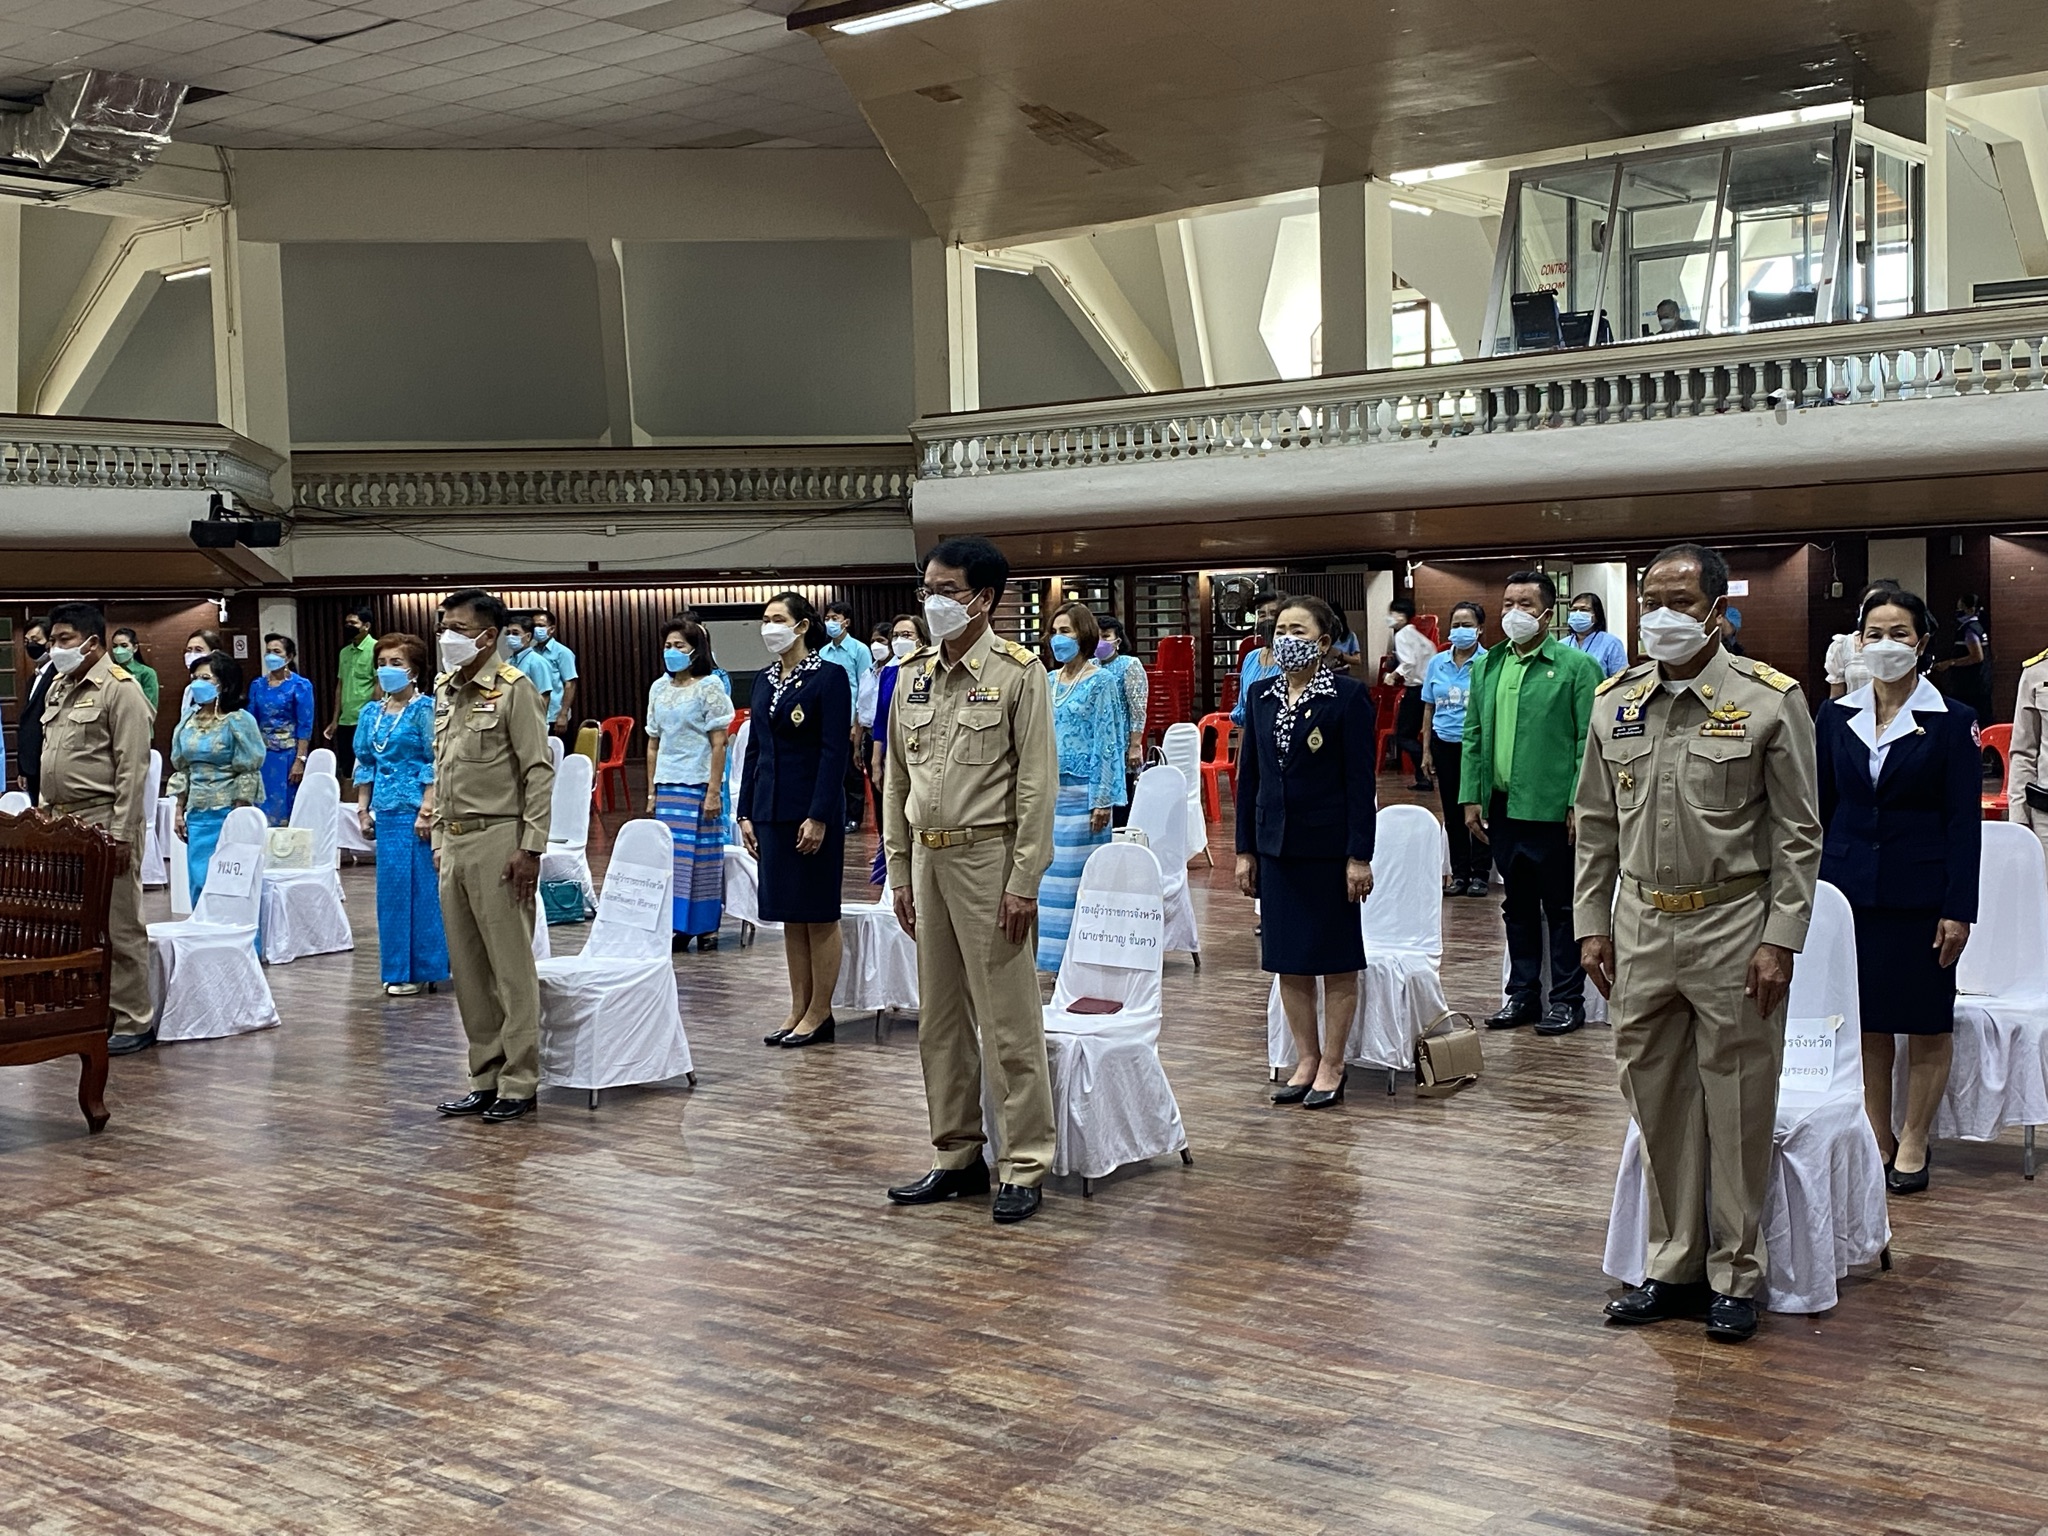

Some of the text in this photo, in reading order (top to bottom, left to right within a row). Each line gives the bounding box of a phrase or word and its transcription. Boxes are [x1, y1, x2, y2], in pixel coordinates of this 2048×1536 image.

[1538, 281, 1566, 292] ROOM
[1785, 1034, 1833, 1048] รจังหวัด
